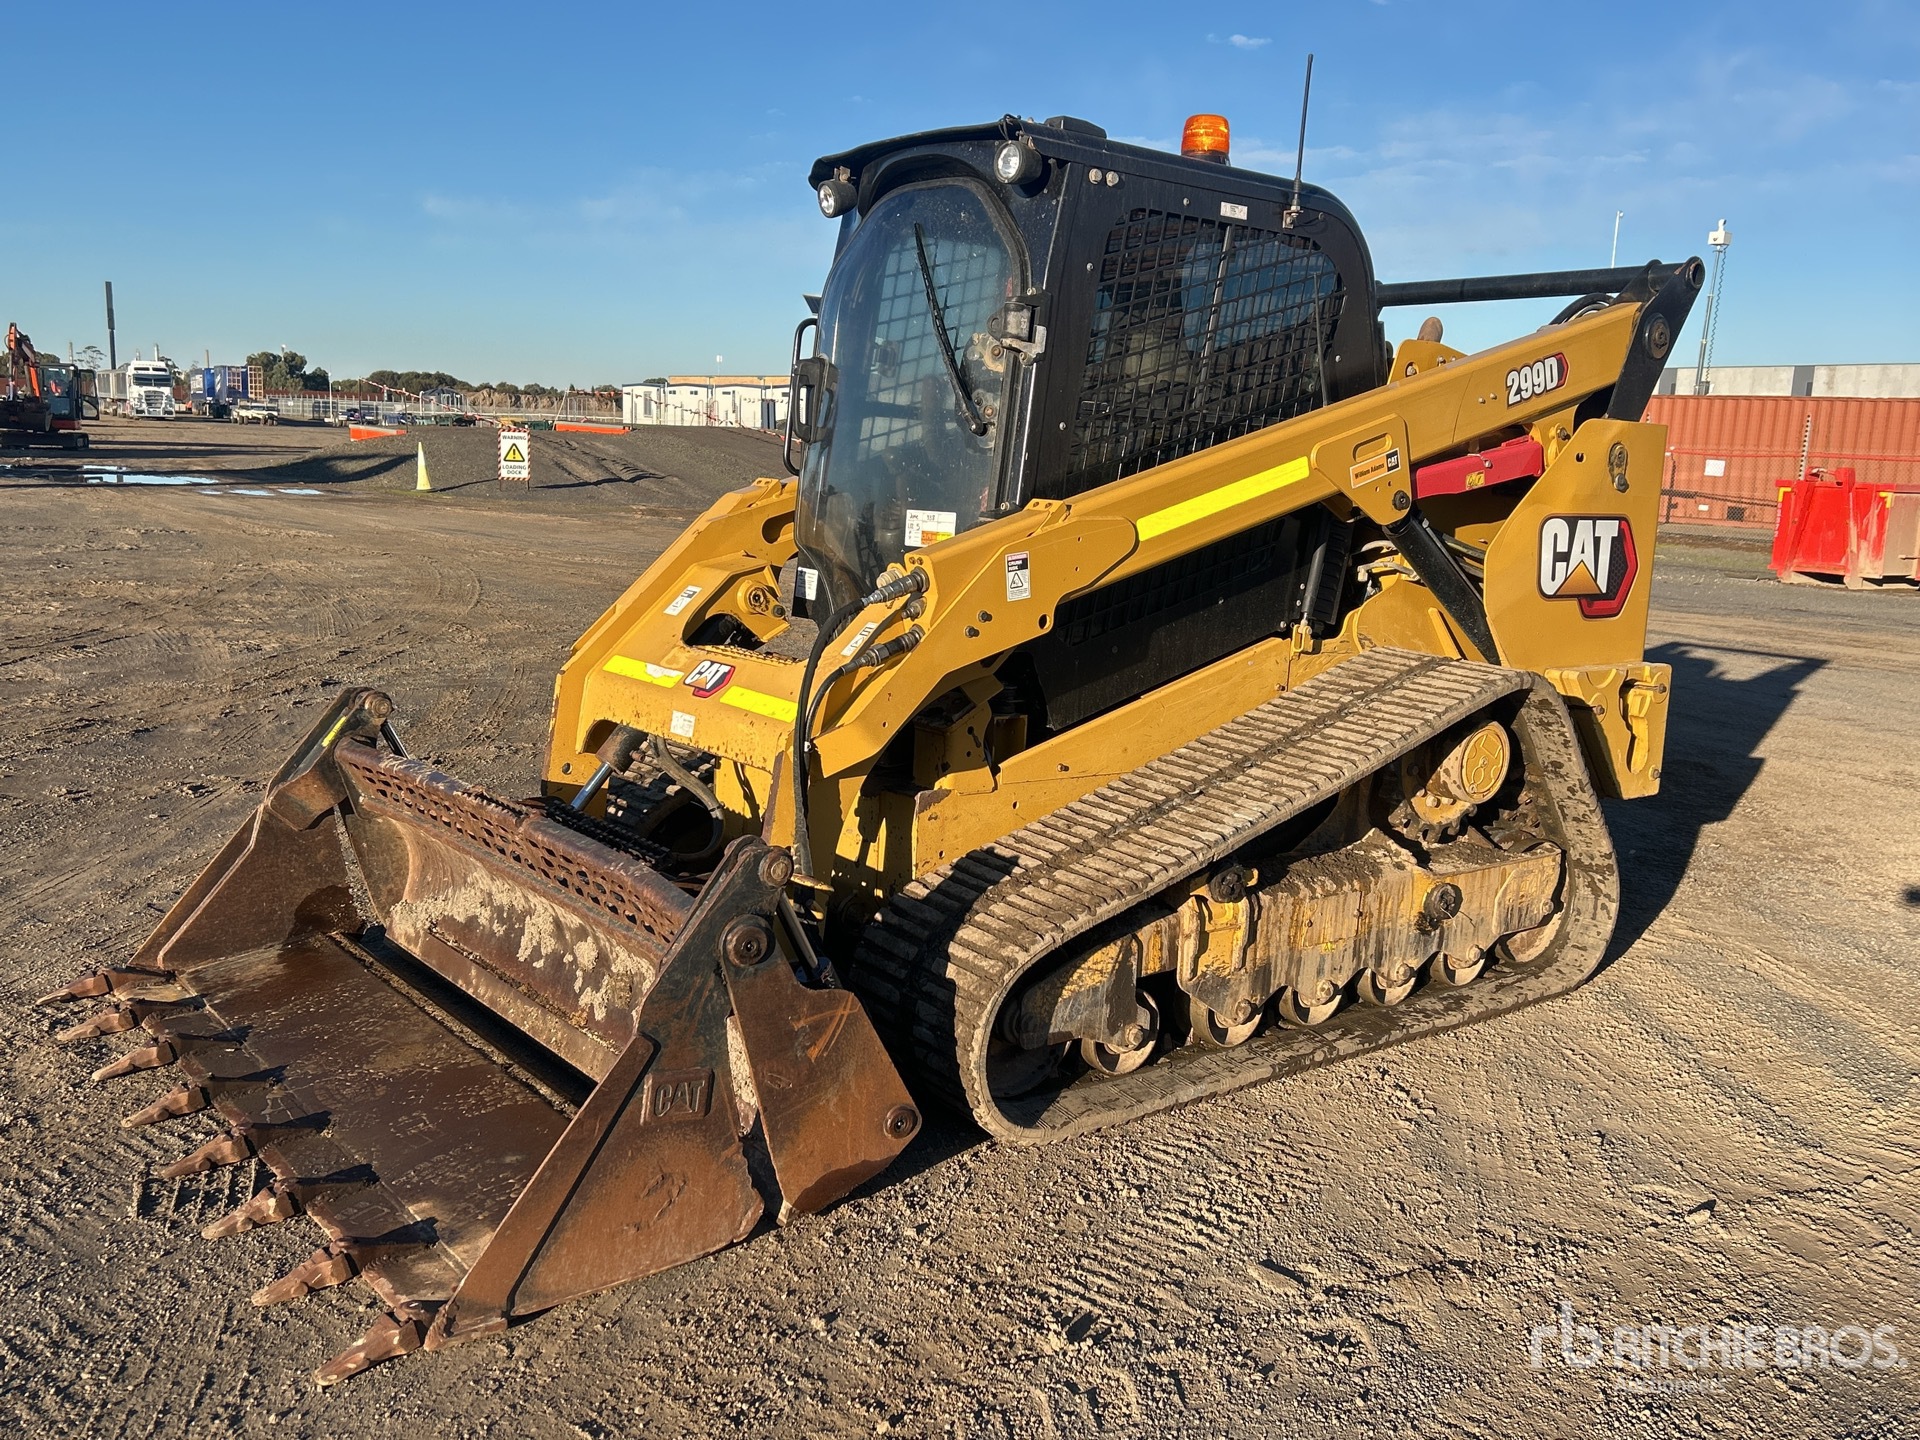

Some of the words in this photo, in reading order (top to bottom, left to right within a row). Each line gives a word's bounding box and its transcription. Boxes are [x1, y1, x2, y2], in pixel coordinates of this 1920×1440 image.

[1506, 356, 1558, 405] 299D
[1354, 468, 1370, 479] William
[1370, 463, 1385, 473] Adams
[1387, 455, 1398, 467] CAT
[1540, 518, 1620, 596] CAT
[684, 660, 732, 690] CAT
[654, 1080, 705, 1117] CAT
